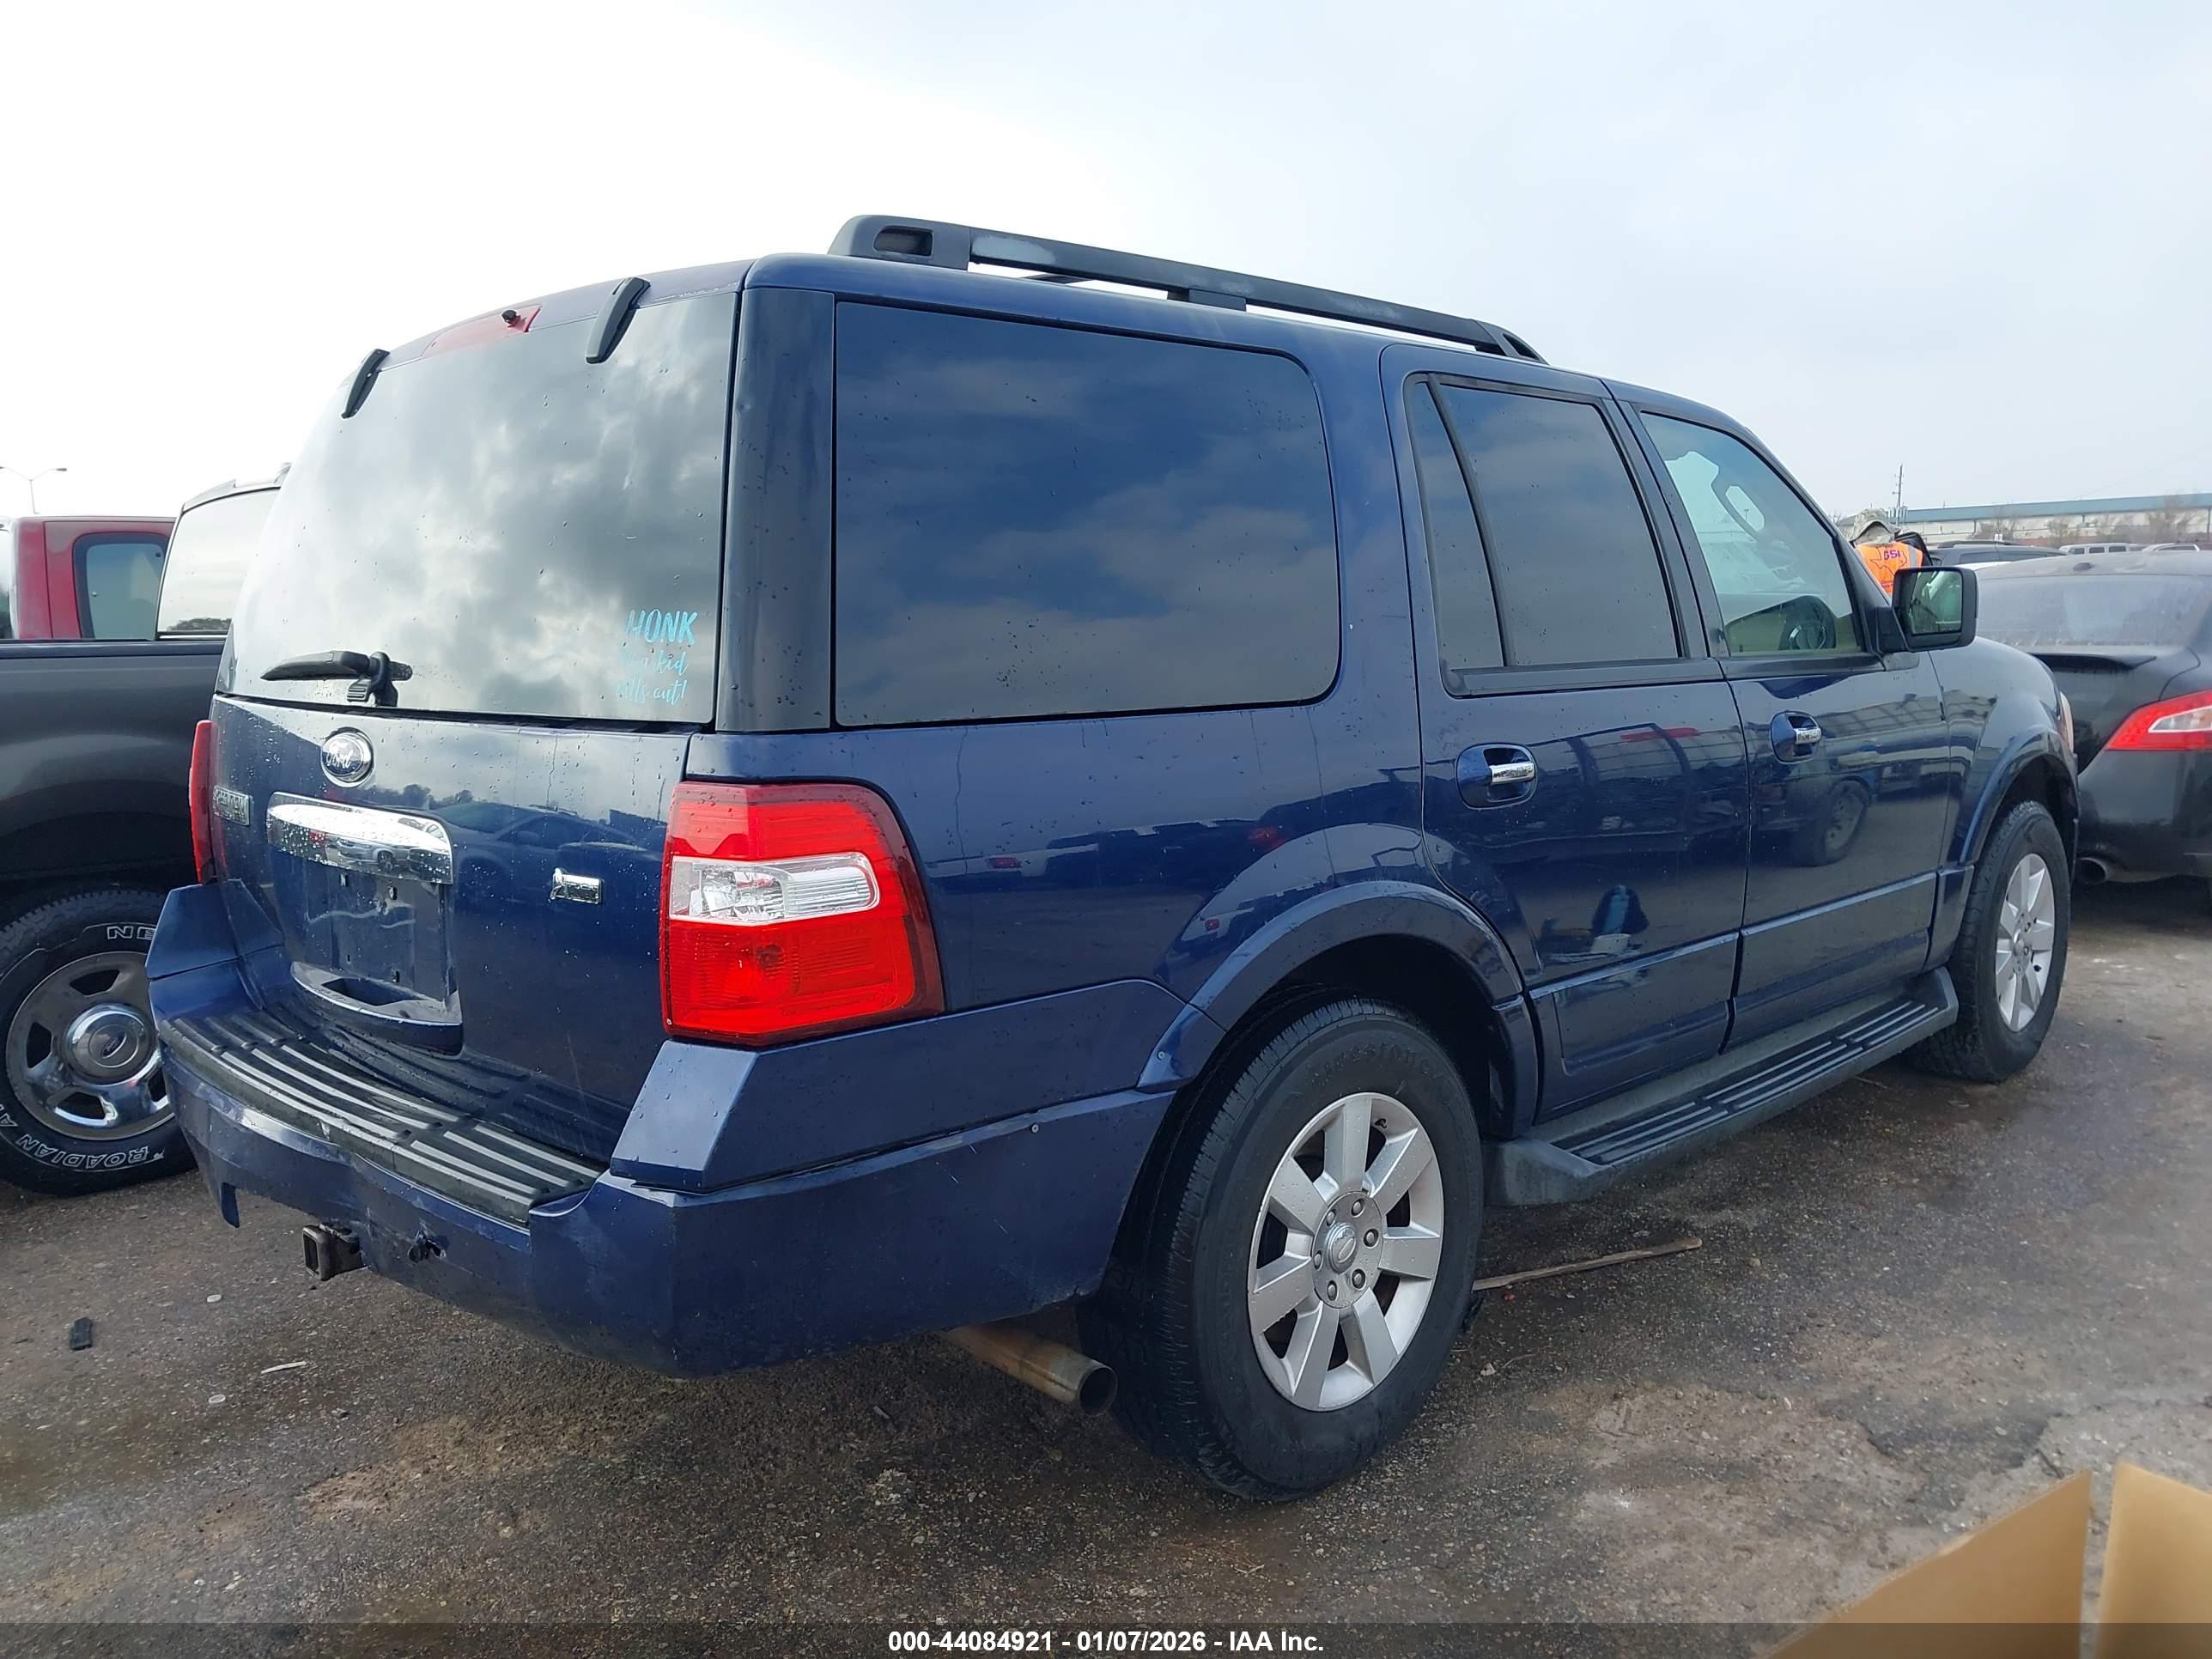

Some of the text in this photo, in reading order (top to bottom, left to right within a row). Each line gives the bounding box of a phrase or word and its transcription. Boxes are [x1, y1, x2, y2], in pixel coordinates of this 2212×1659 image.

[1883, 550, 1901, 561] GSI
[626, 609, 698, 645] HONK
[656, 649, 689, 676] kid
[15, 1133, 149, 1169] ROADIAN
